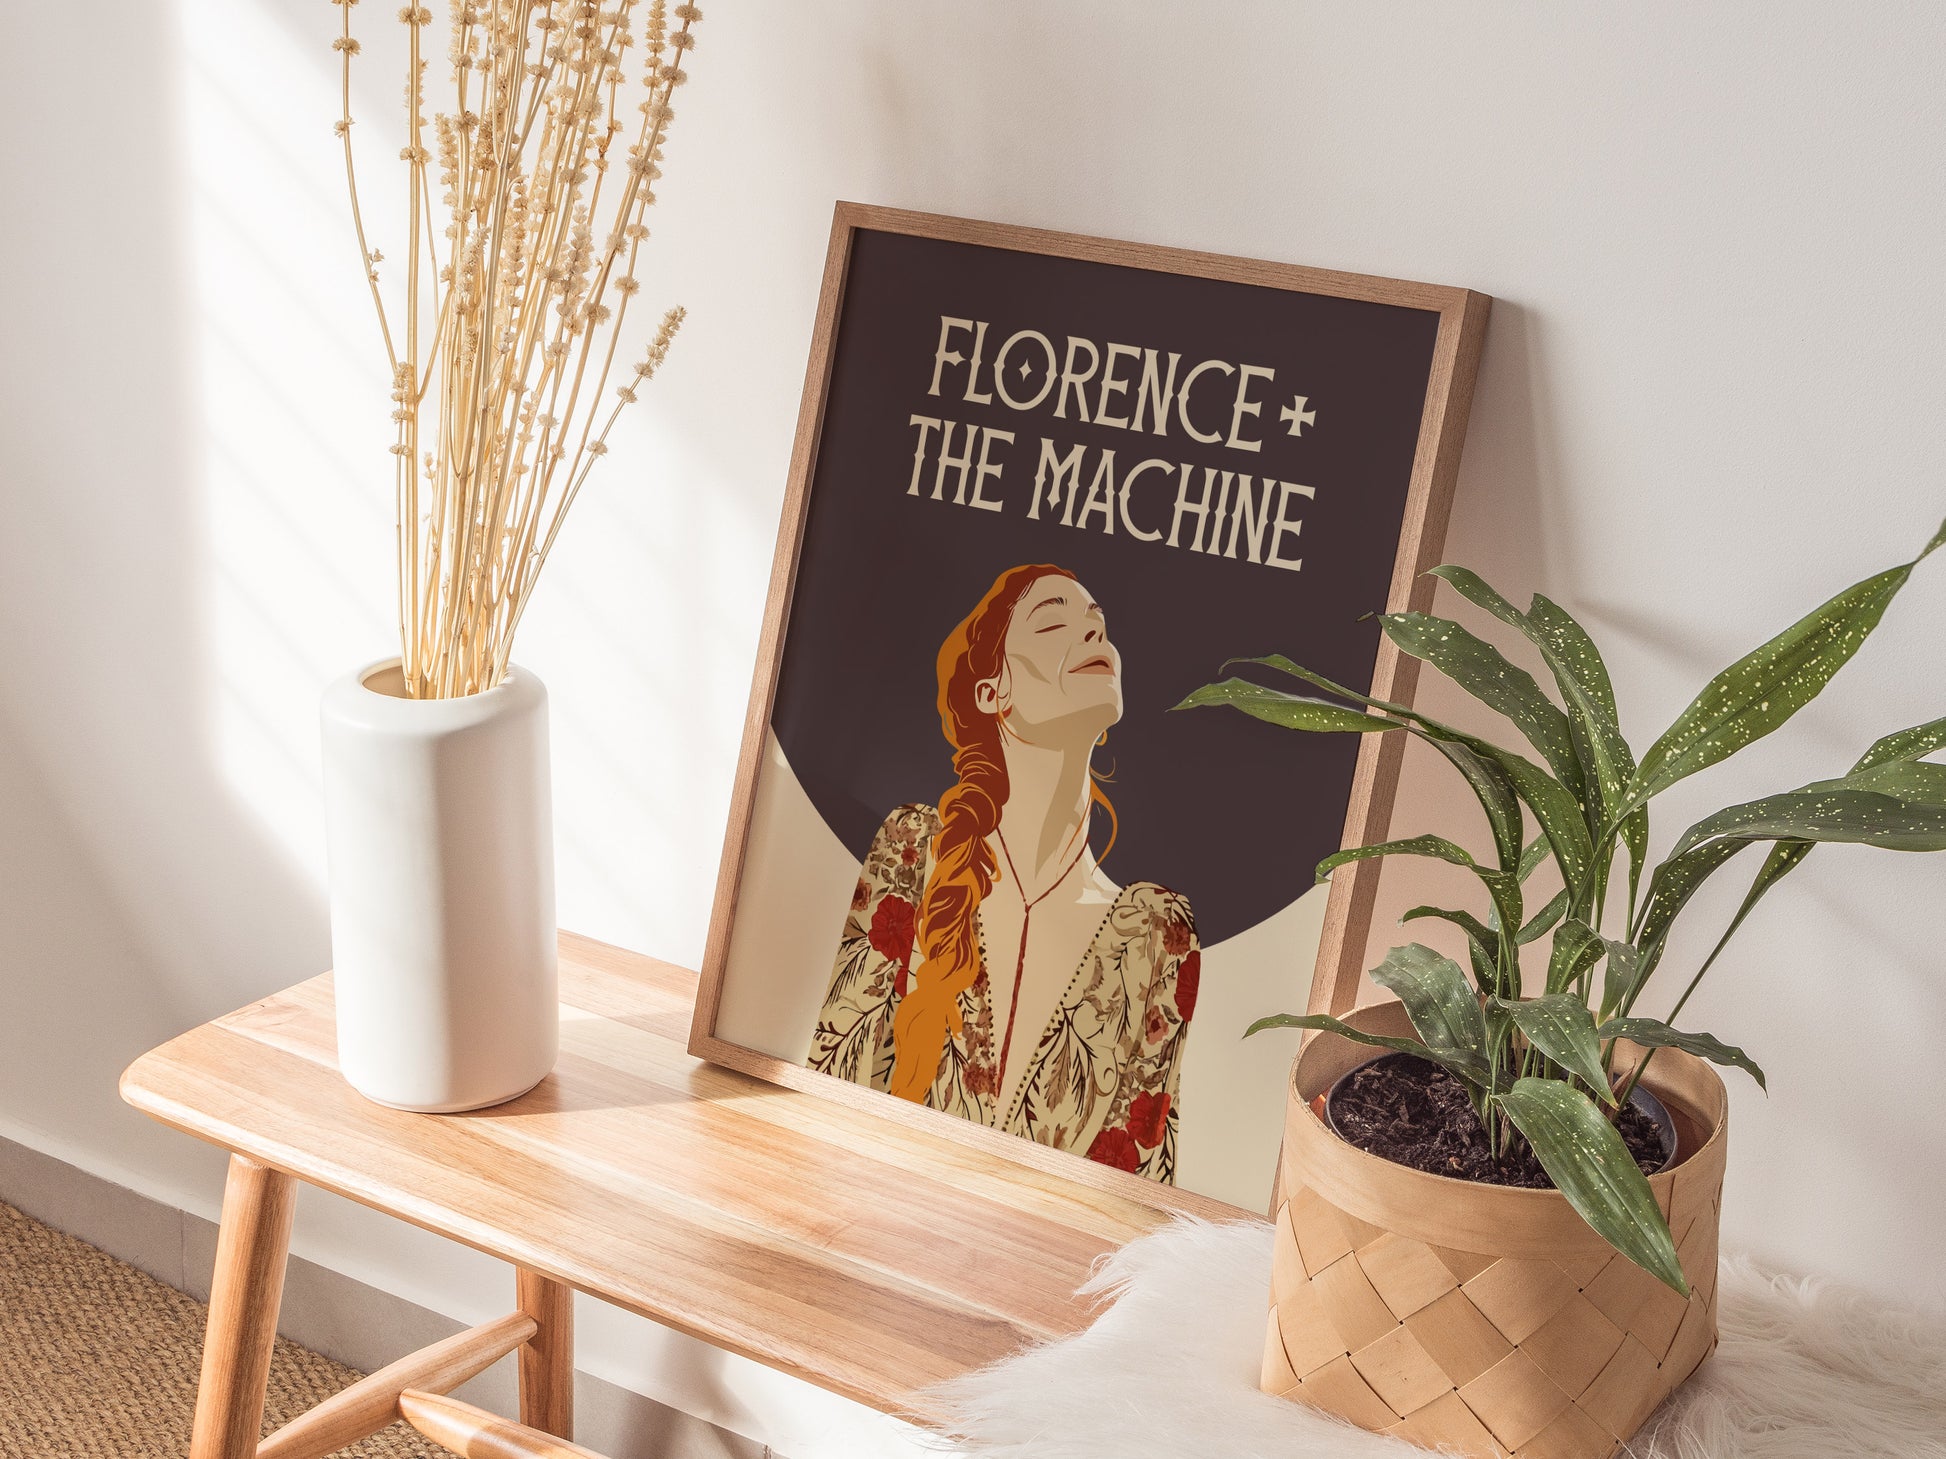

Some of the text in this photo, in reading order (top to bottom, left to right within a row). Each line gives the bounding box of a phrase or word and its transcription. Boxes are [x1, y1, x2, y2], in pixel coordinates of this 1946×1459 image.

[927, 315, 1276, 453] FLORENCE
[906, 413, 1316, 572] THE MACHINE
